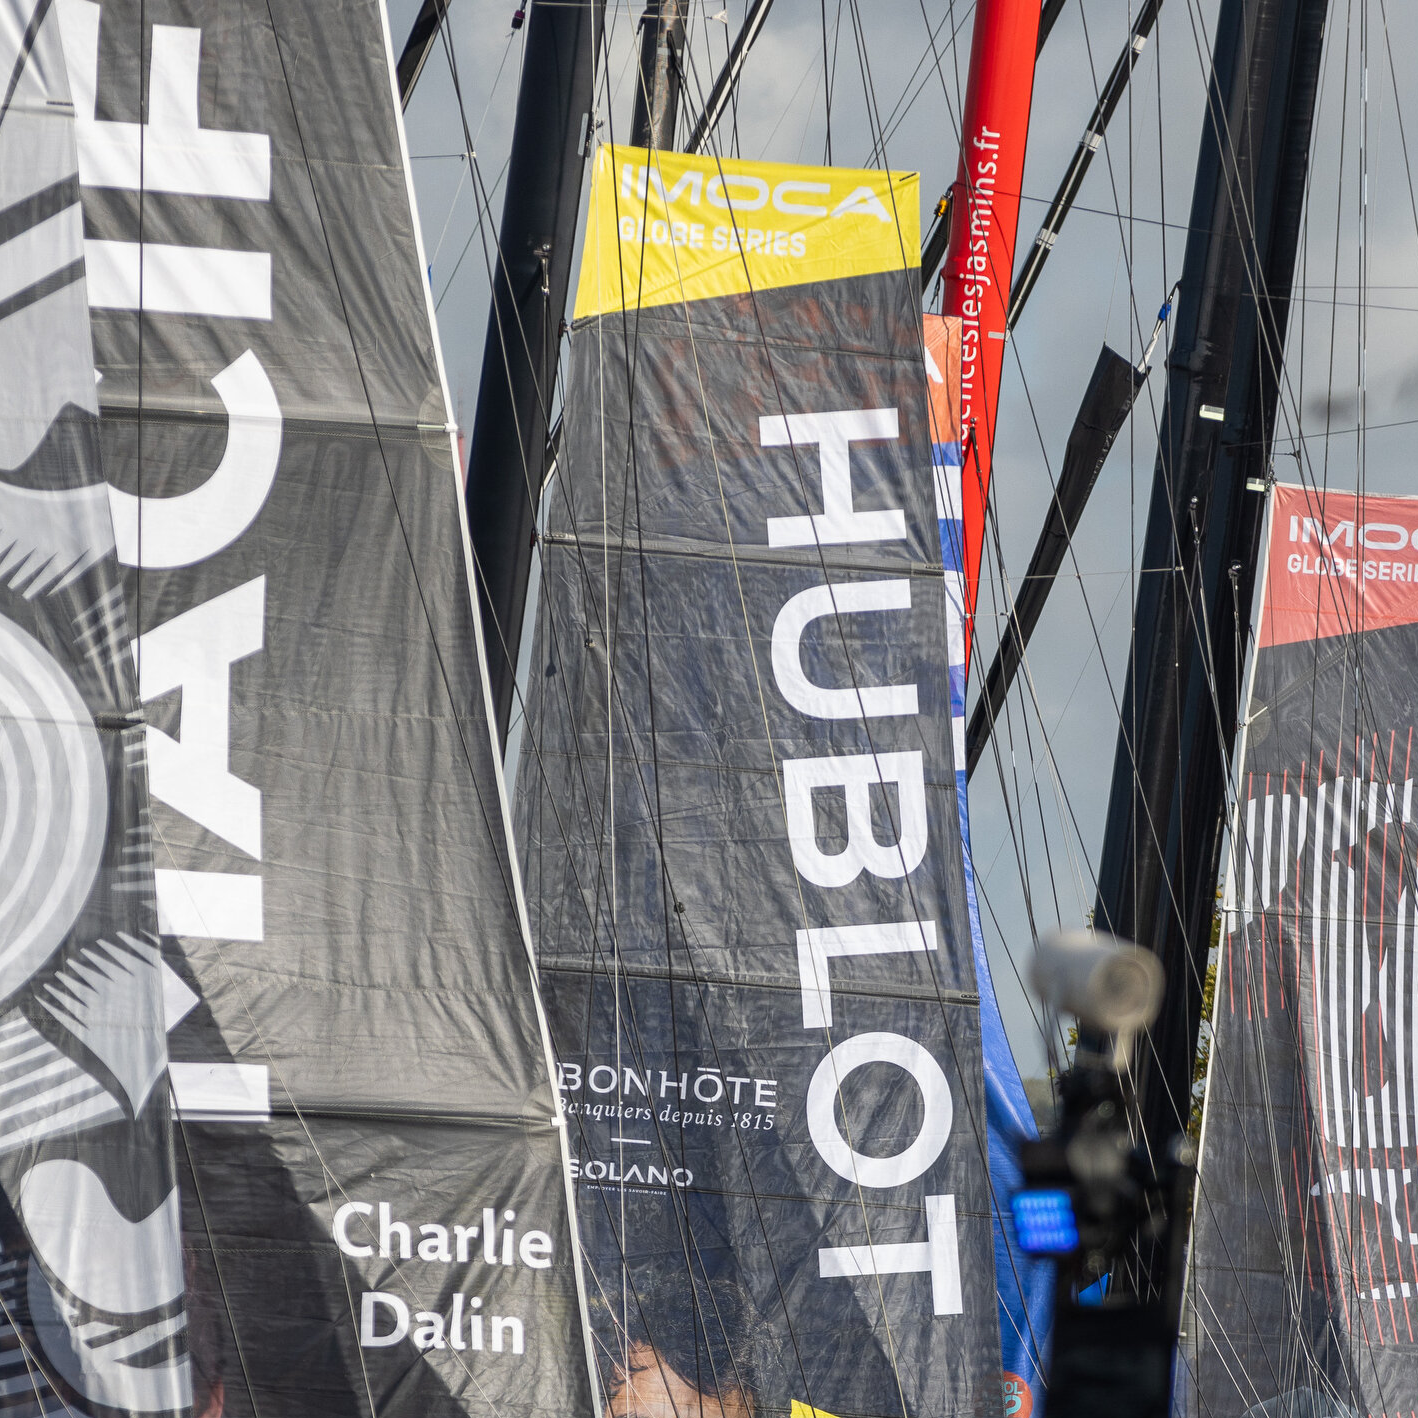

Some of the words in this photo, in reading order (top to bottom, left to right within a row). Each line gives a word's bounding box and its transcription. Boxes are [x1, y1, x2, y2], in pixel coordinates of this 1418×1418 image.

[621, 163, 892, 223] IMOCA
[619, 215, 705, 250] GLOBE
[712, 226, 806, 257] SERIES
[1287, 554, 1357, 578] GLOBE
[759, 408, 963, 1315] HUBLOT
[559, 1097, 652, 1123] Banquiers
[659, 1105, 723, 1129] depuis
[731, 1112, 775, 1131] 1815
[567, 1158, 694, 1187] SOLANO
[333, 1201, 553, 1269] Charlie
[361, 1291, 524, 1355] Dalin
